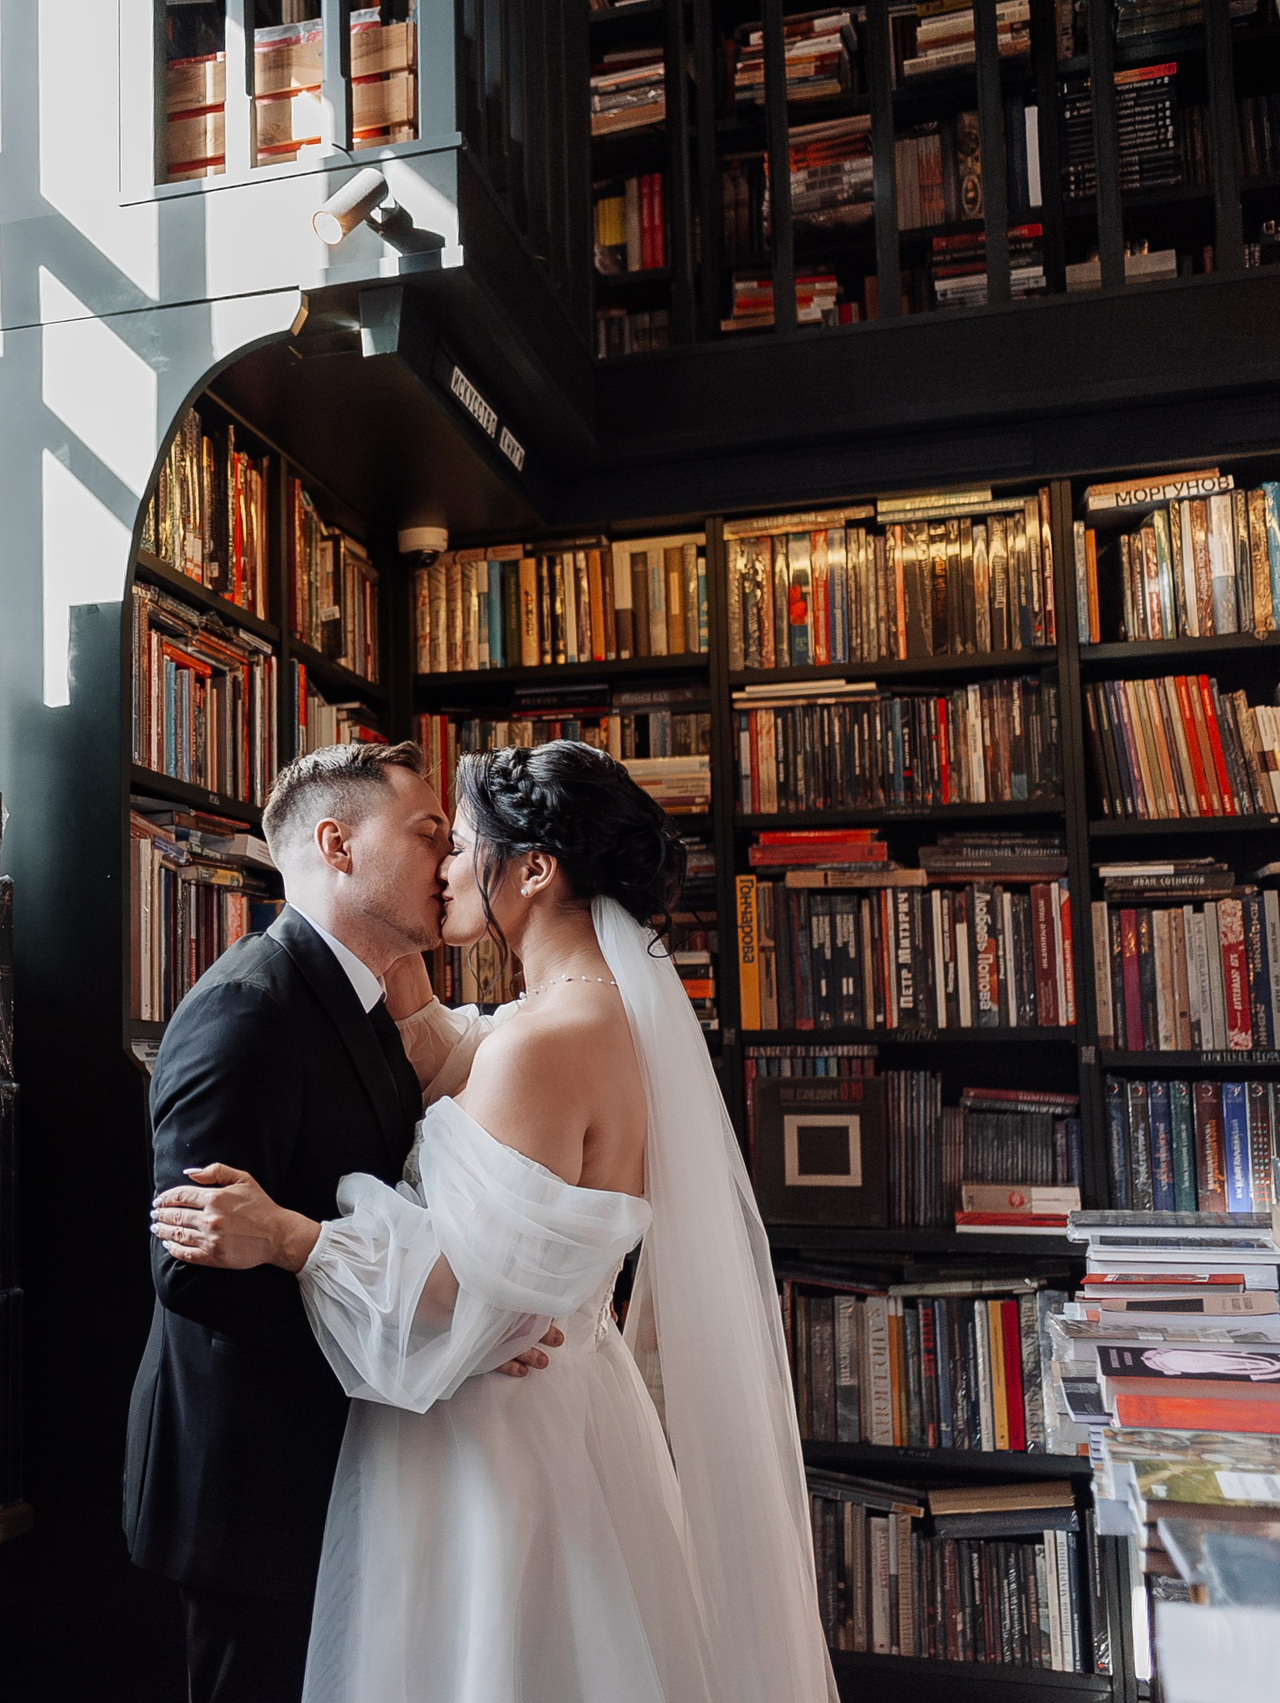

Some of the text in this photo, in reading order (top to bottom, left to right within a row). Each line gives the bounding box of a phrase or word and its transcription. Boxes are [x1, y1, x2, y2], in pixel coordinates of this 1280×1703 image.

[1115, 475, 1230, 506] МОРГУНОВ
[739, 878, 755, 964] Гончарова
[897, 892, 913, 1008] ПЕТР МИТУРИЧ
[974, 890, 994, 1011] Любовь Попова
